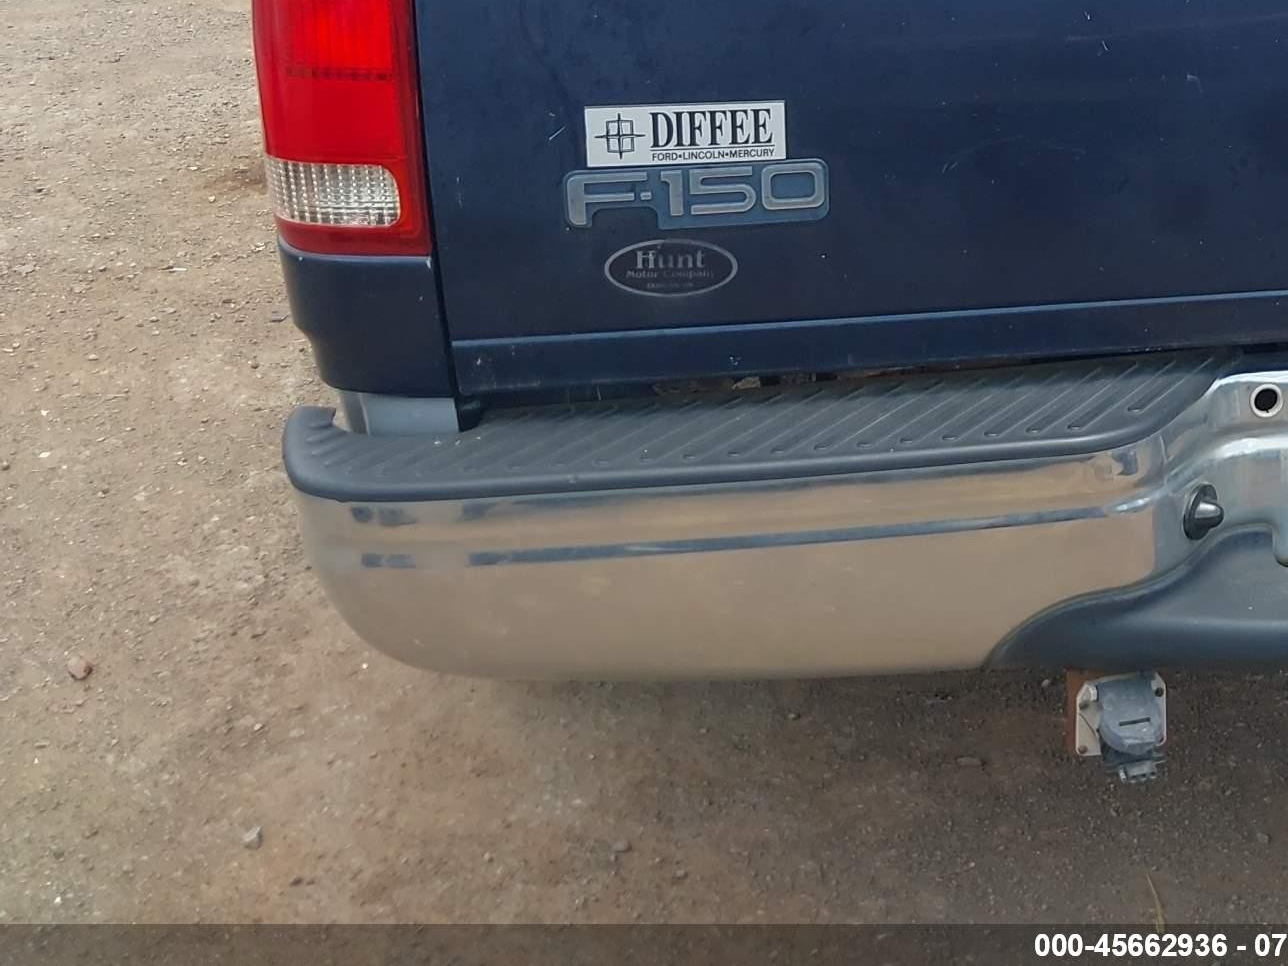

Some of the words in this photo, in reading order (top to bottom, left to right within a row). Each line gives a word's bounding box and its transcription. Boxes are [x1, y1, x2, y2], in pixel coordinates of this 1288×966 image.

[649, 108, 773, 148] DIFFEE
[566, 162, 826, 226] F-150
[636, 250, 704, 269] Hunt
